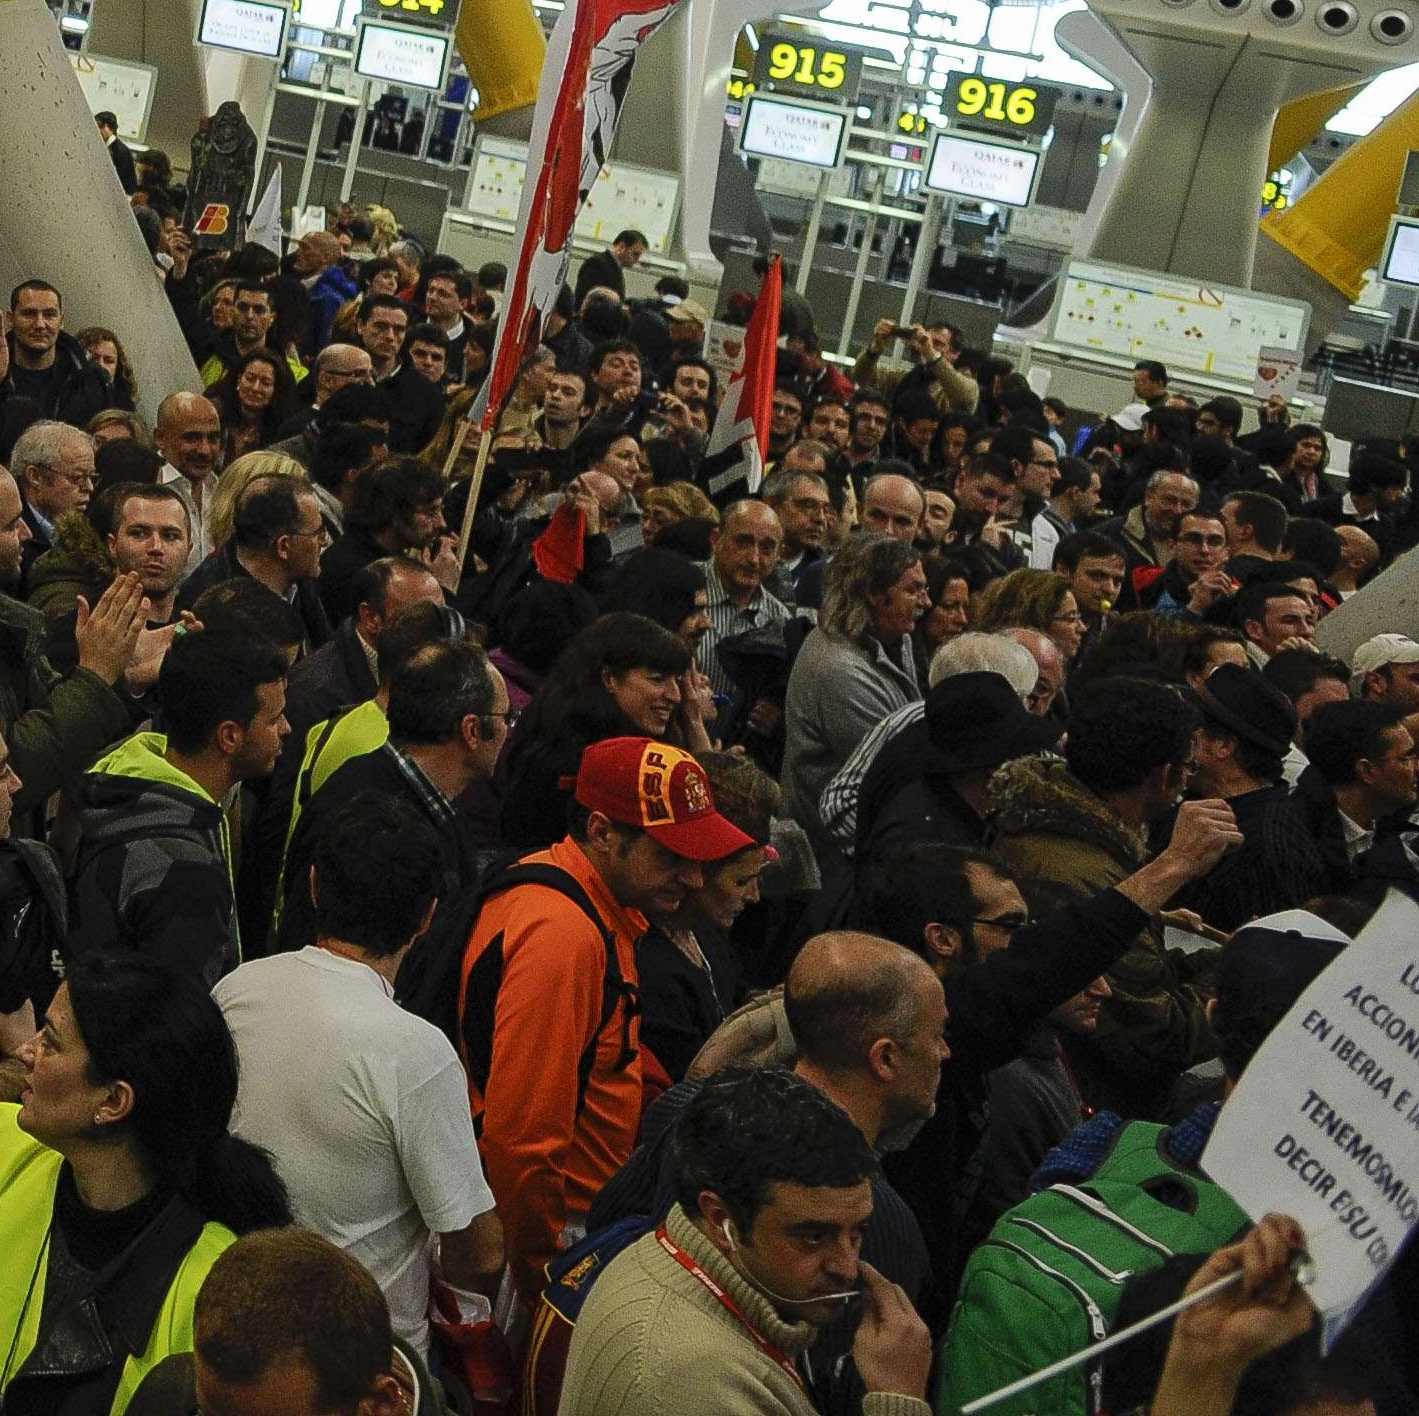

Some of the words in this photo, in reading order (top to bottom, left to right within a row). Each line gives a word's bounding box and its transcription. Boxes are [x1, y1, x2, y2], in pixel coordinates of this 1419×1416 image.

[769, 43, 847, 89] 915
[957, 78, 1038, 125] 916
[1301, 1008, 1335, 1043] EN
[1330, 1031, 1397, 1101] IBERIA
[1274, 1133, 1338, 1199] DECIR
